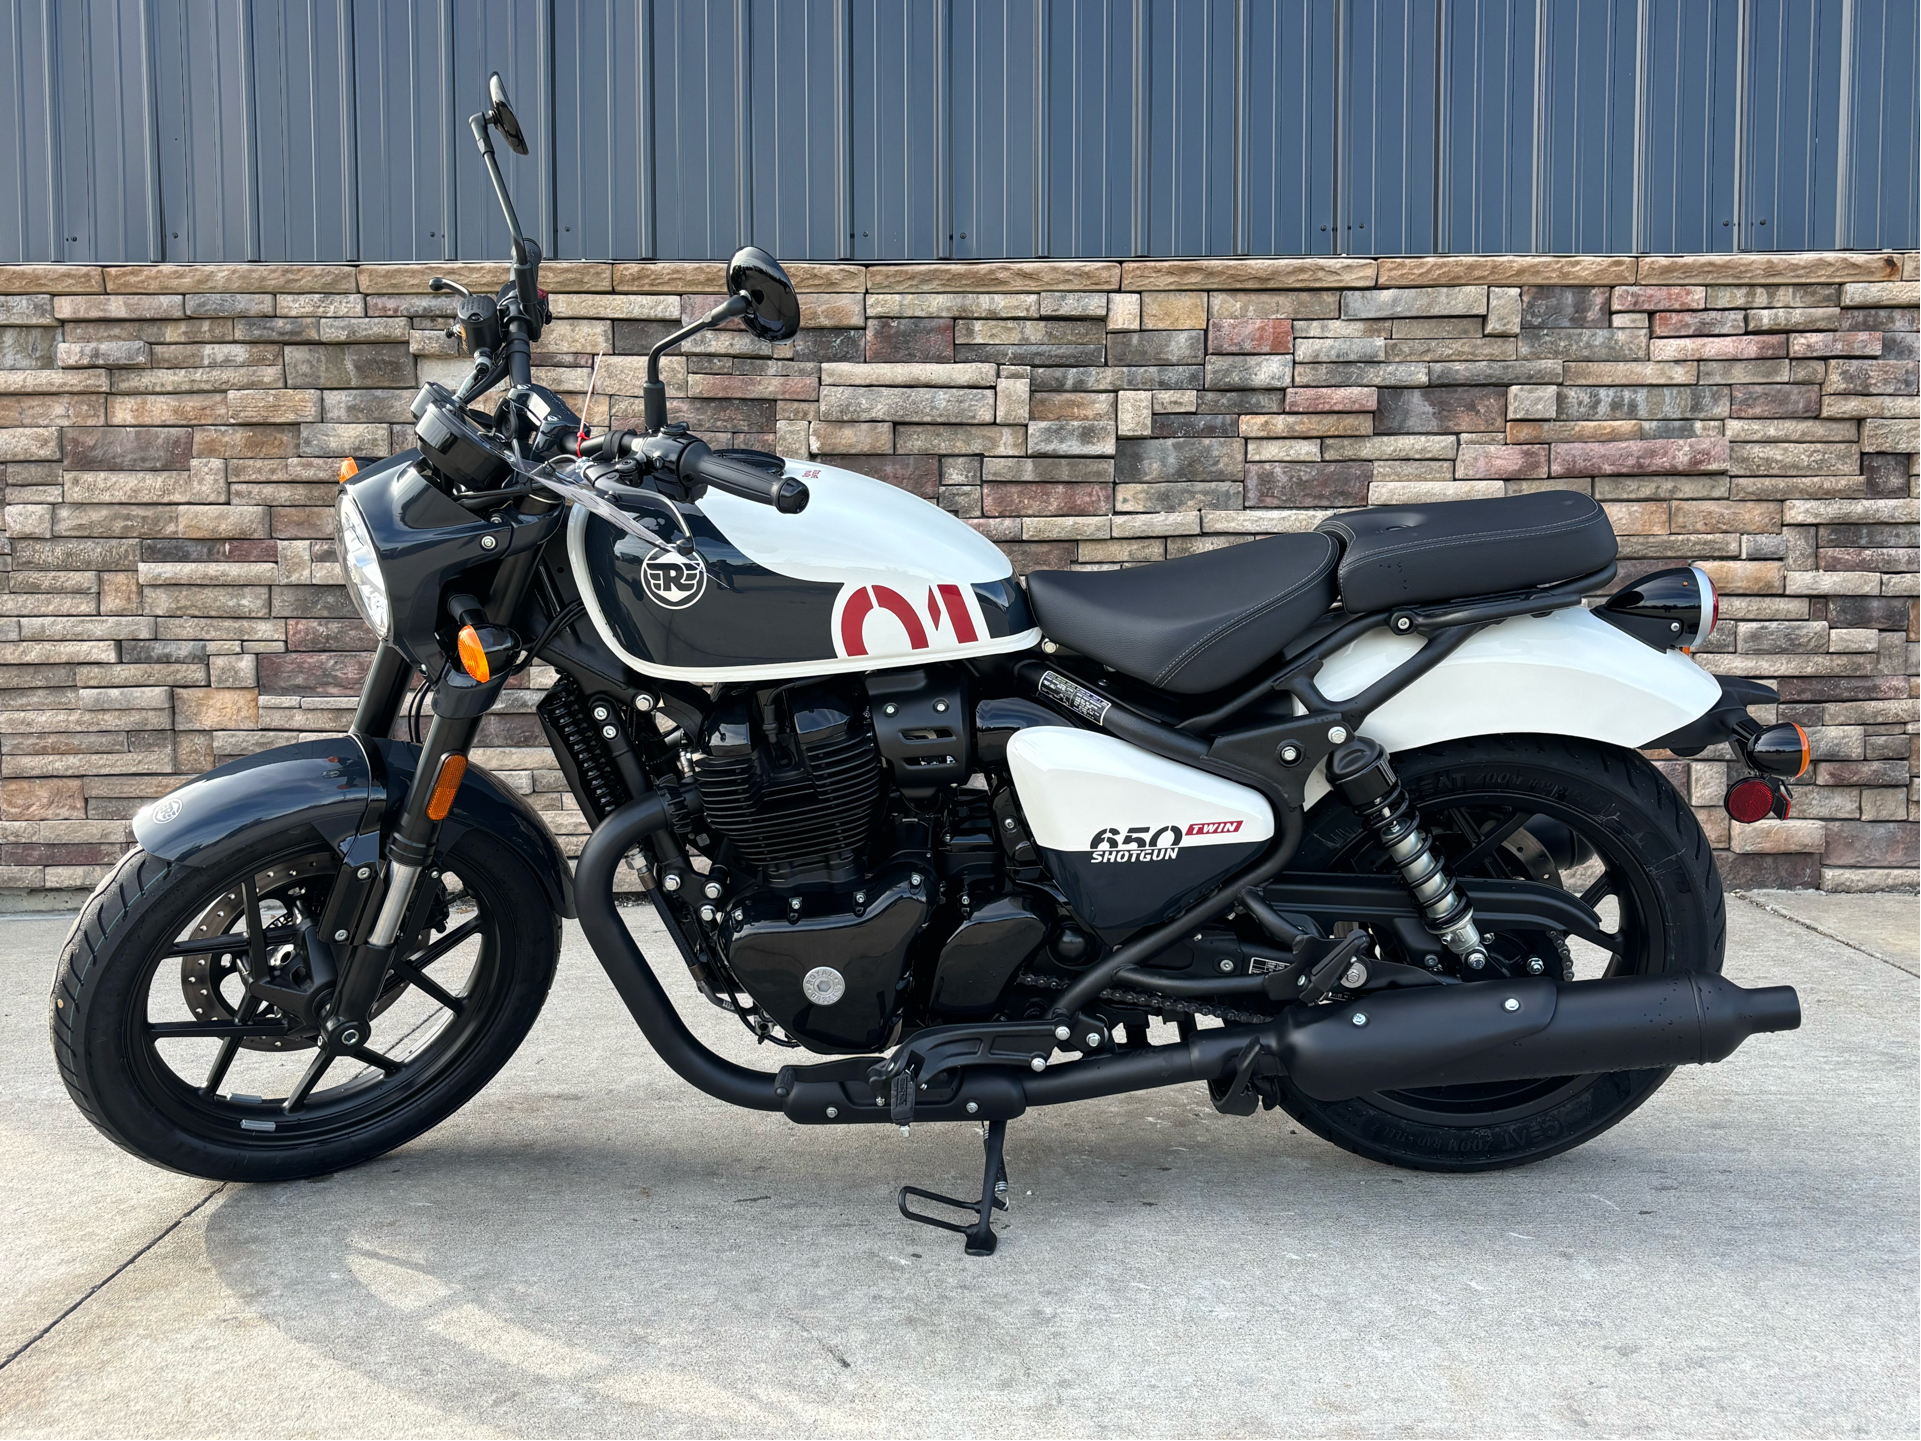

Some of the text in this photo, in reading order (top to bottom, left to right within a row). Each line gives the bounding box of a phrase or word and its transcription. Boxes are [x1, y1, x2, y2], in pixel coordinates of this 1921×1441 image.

[841, 584, 979, 657] 01
[1474, 772, 1524, 785] ZOOM
[1090, 822, 1238, 849] 650 TWIN
[1091, 848, 1178, 863] SHOTGUN
[806, 970, 833, 986] ROYAL
[1502, 1121, 1560, 1150] CEAT
